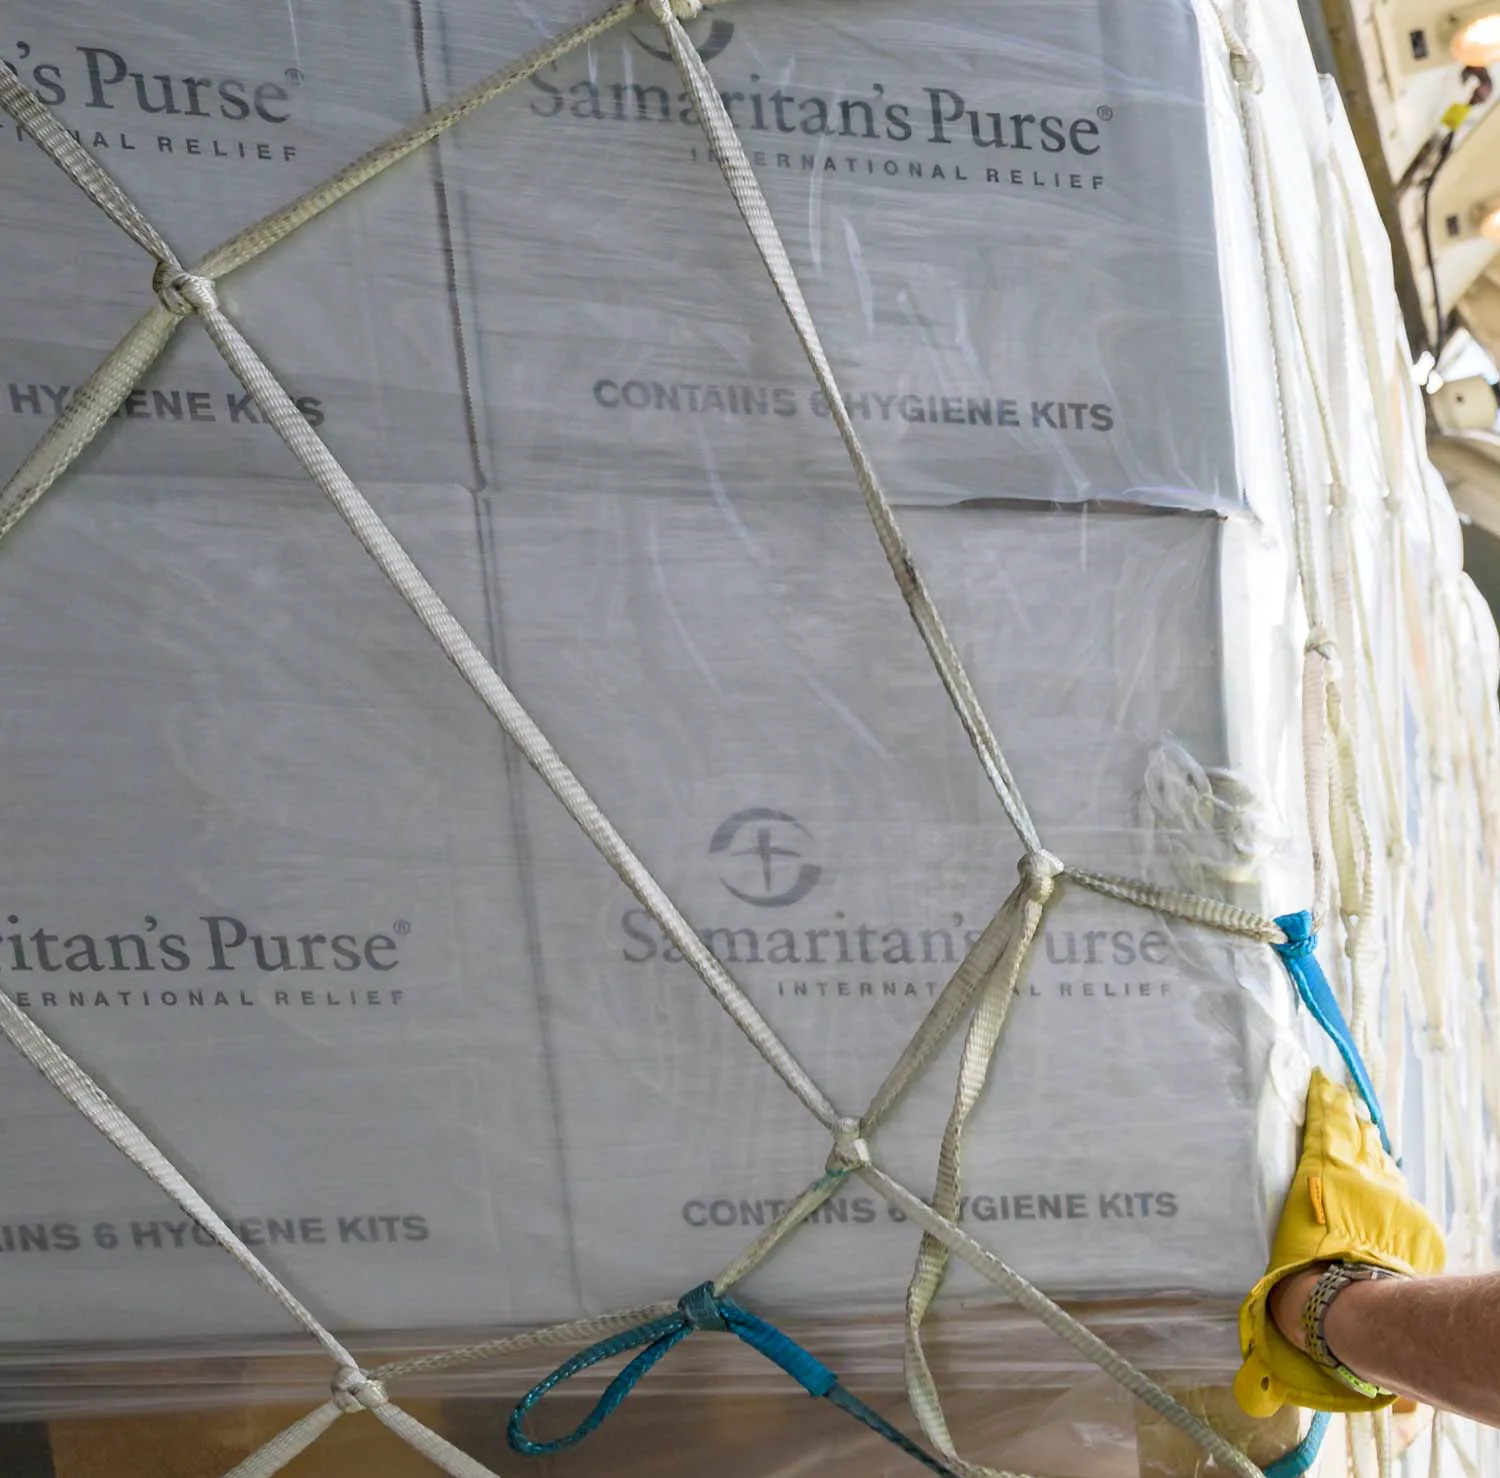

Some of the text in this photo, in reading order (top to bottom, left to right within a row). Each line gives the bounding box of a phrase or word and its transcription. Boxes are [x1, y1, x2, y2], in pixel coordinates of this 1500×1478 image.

[157, 135, 297, 161] RELIEF
[986, 167, 1105, 190] RELIEF
[593, 378, 797, 417] CONTAINS
[845, 390, 1021, 428] HYGIENE
[1030, 400, 1115, 432] KITS
[274, 991, 406, 1007] RELIEF
[1060, 982, 1173, 998] RELIEF
[1100, 1191, 1179, 1219] KITS
[94, 1221, 118, 1249] 6
[338, 1214, 430, 1244] KITS
